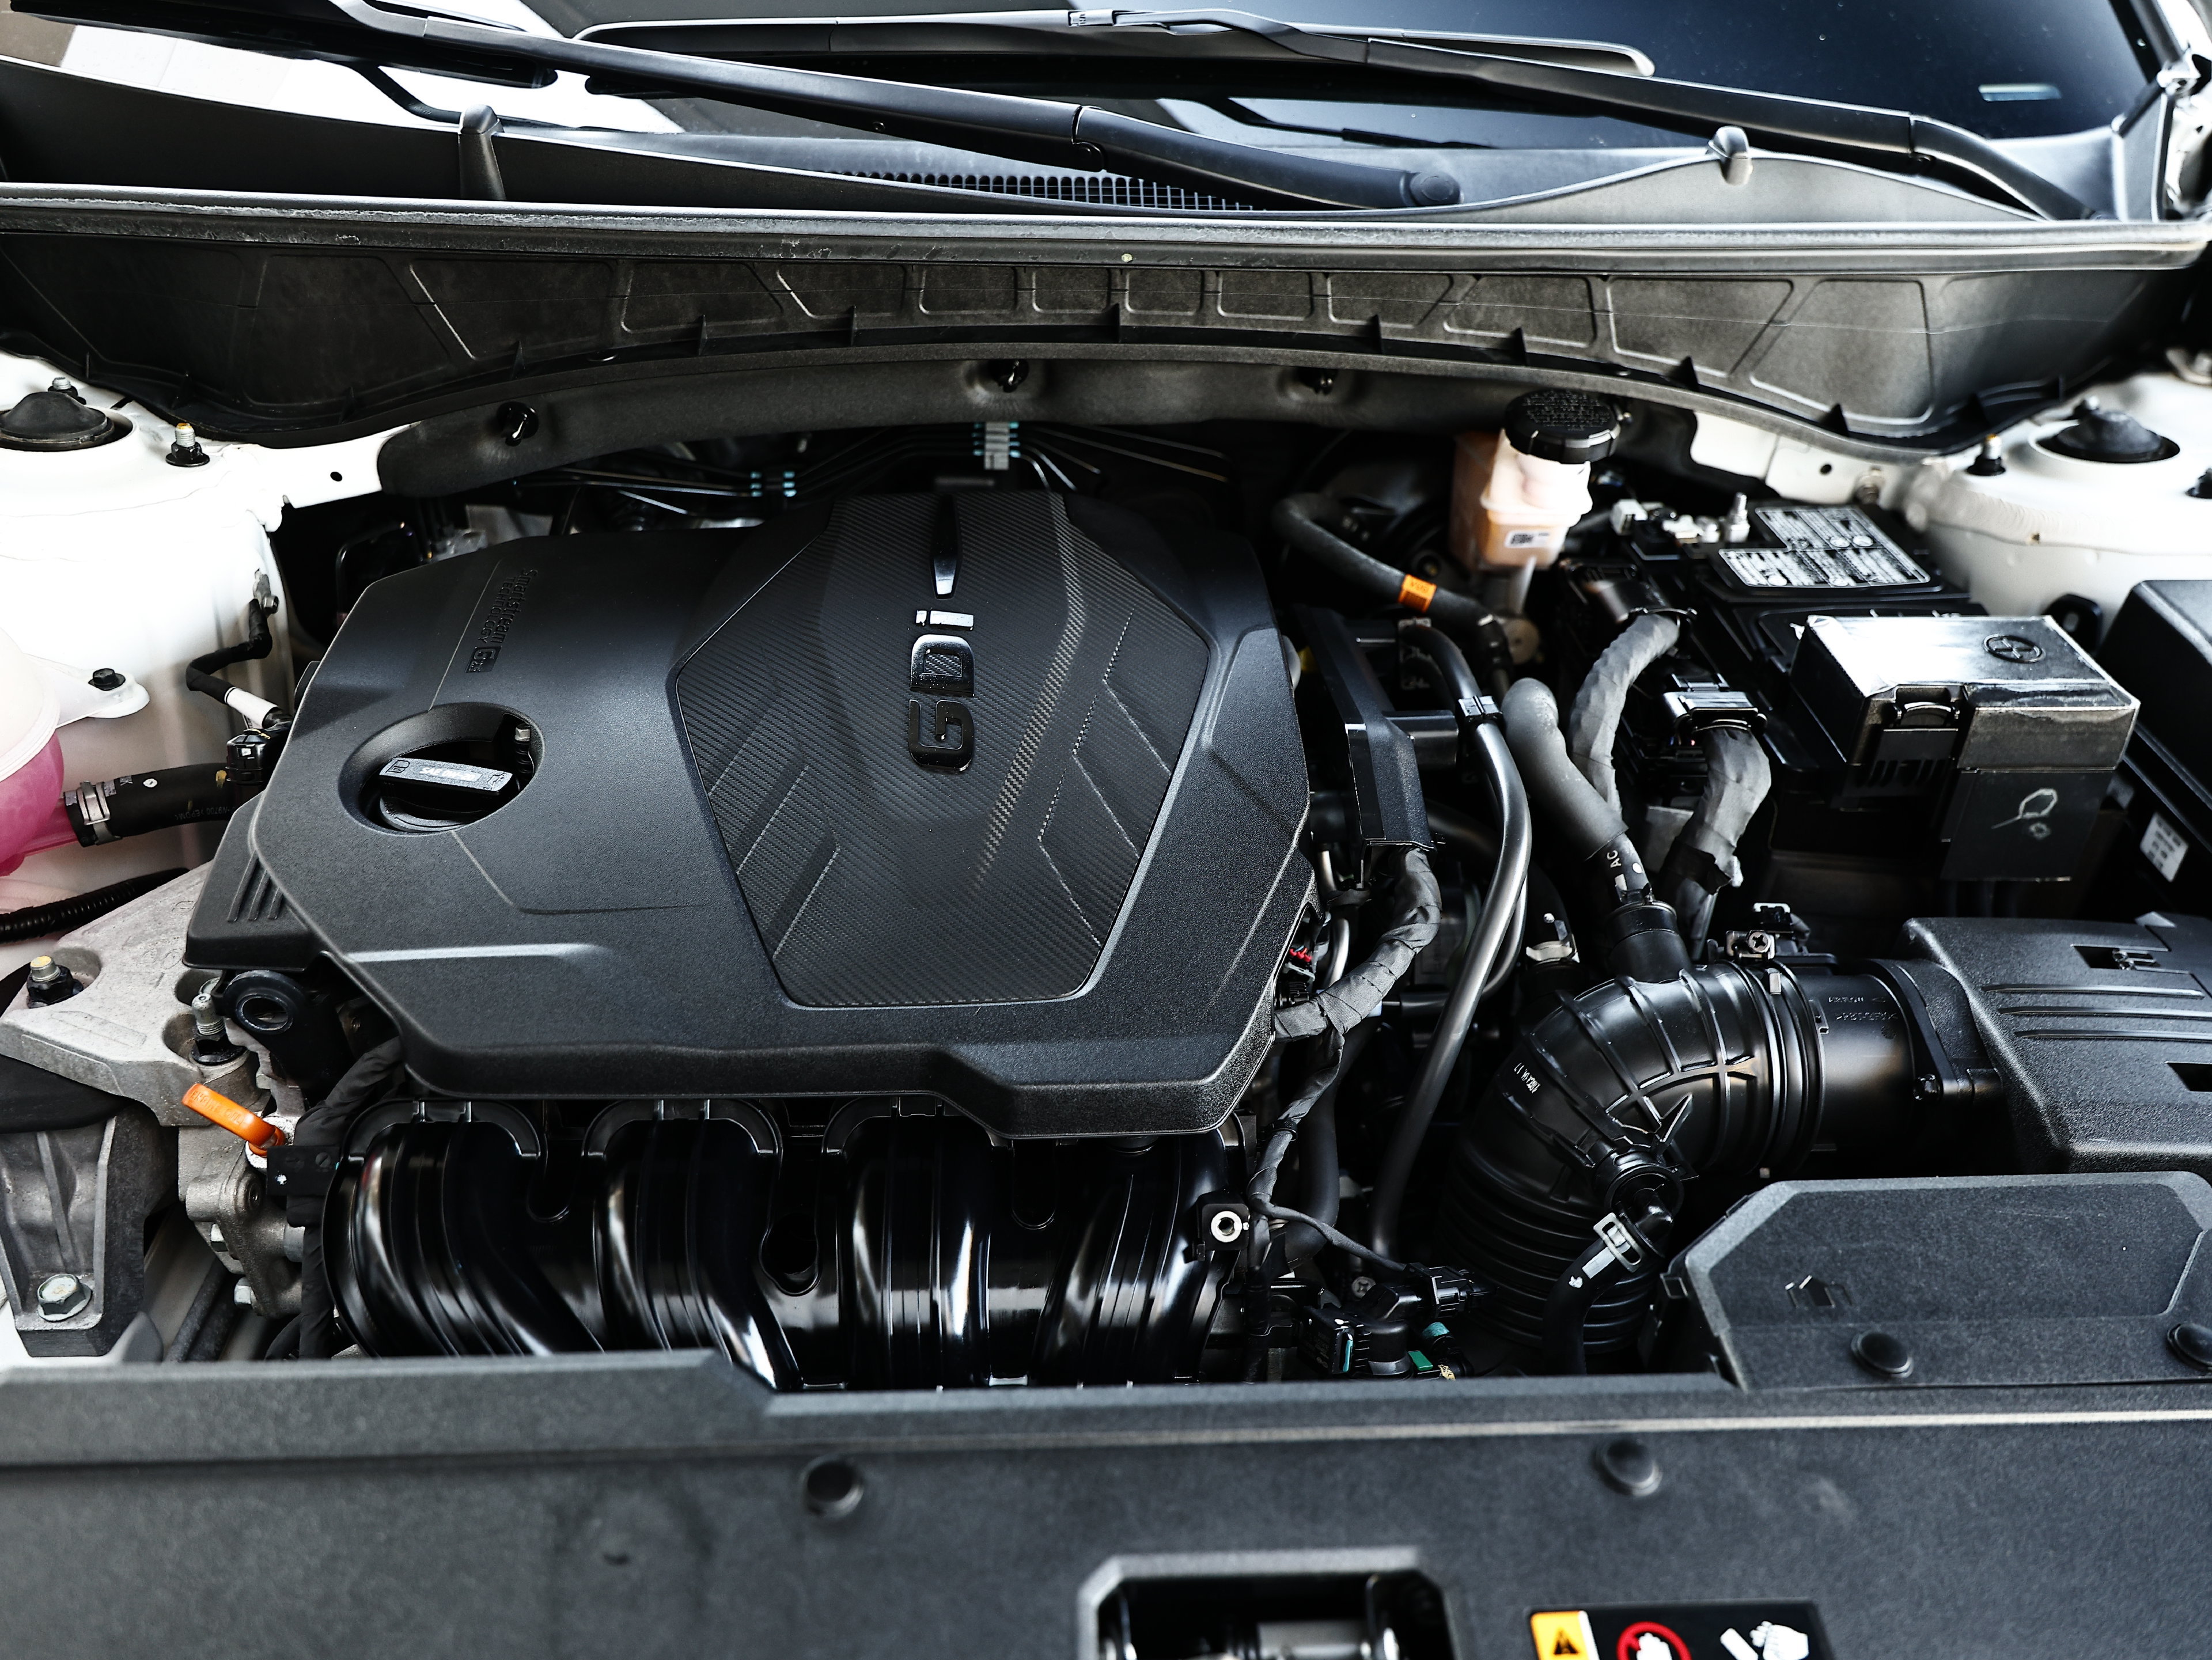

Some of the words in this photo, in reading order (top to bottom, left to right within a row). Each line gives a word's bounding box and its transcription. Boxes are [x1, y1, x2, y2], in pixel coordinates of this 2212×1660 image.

[478, 577, 516, 643] TECHNOLOGY
[491, 569, 538, 643] Smartstream
[908, 609, 975, 773] GDi
[421, 767, 442, 776] SAE
[1607, 850, 1622, 868] AC
